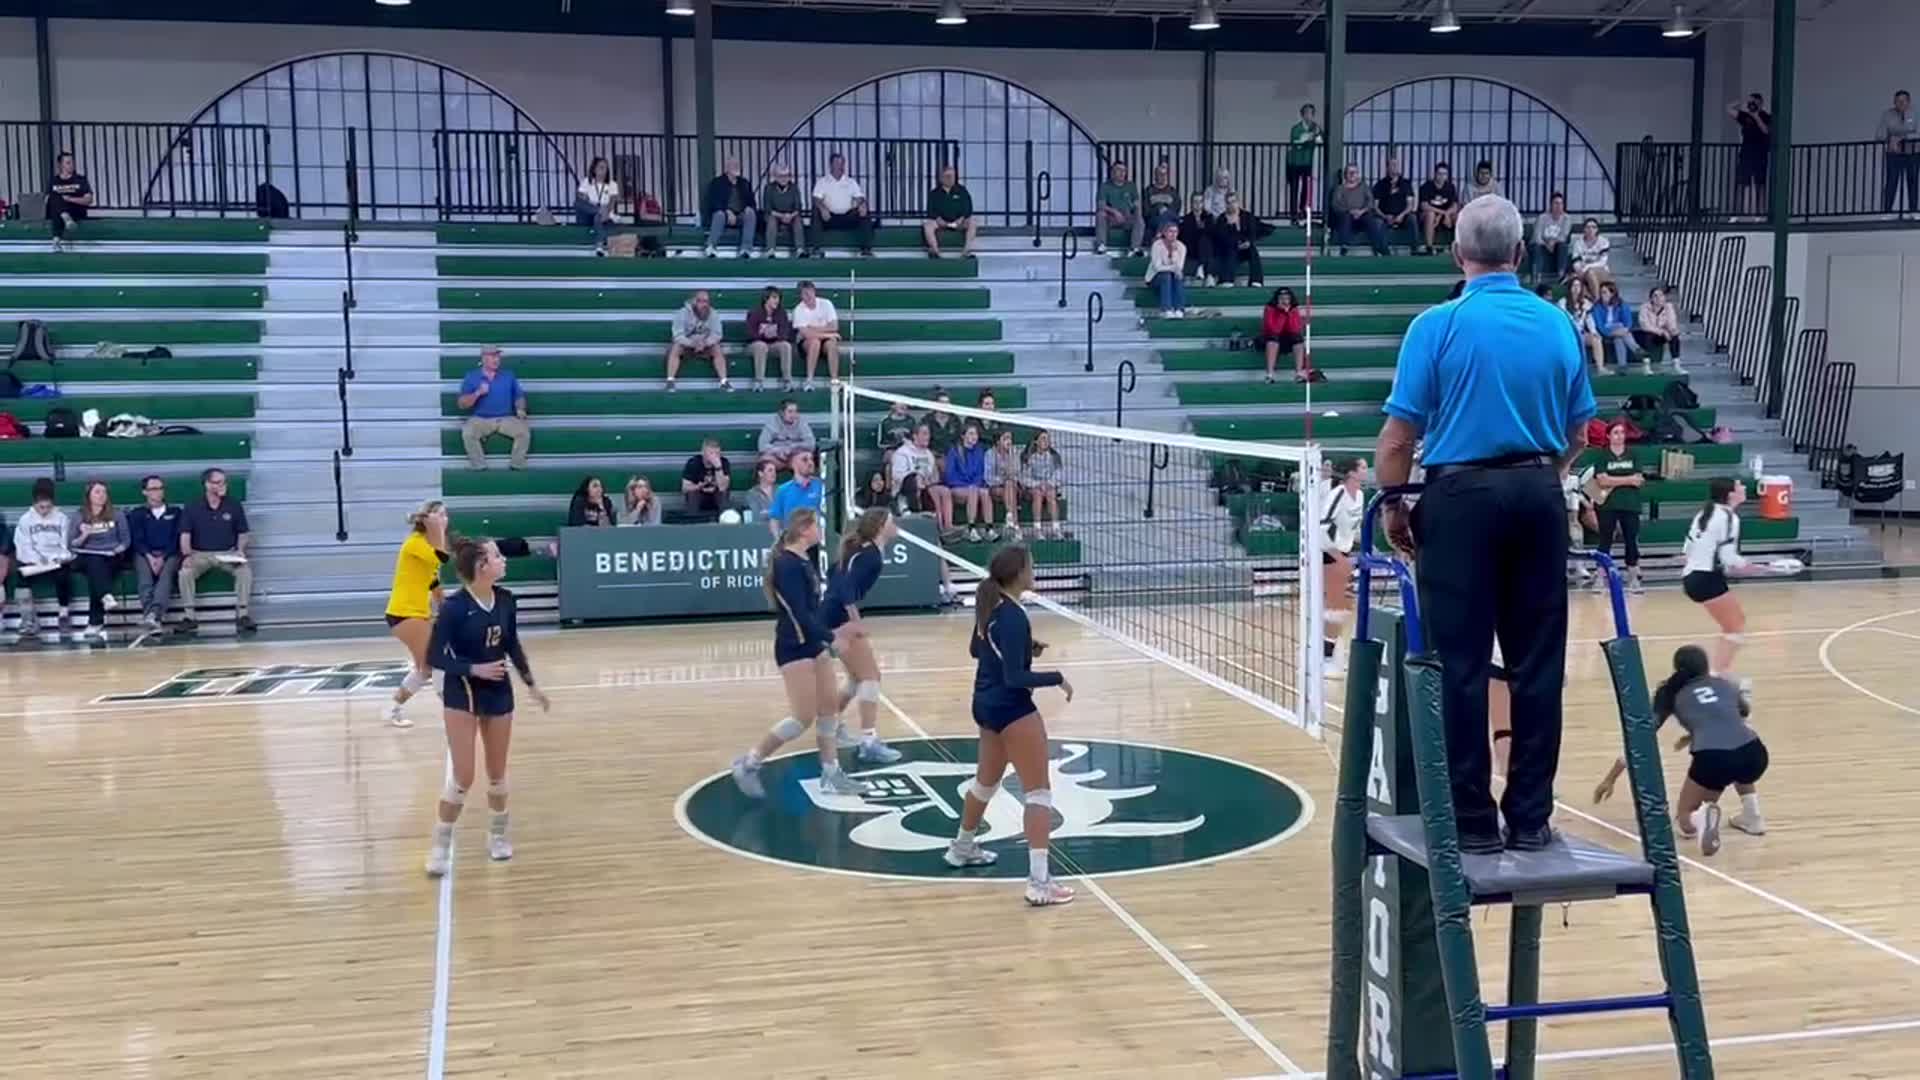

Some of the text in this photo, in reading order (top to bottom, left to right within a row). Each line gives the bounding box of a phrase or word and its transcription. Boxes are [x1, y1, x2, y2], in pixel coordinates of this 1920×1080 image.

[700, 575, 764, 590] OF RICH
[1692, 686, 1719, 704] 2
